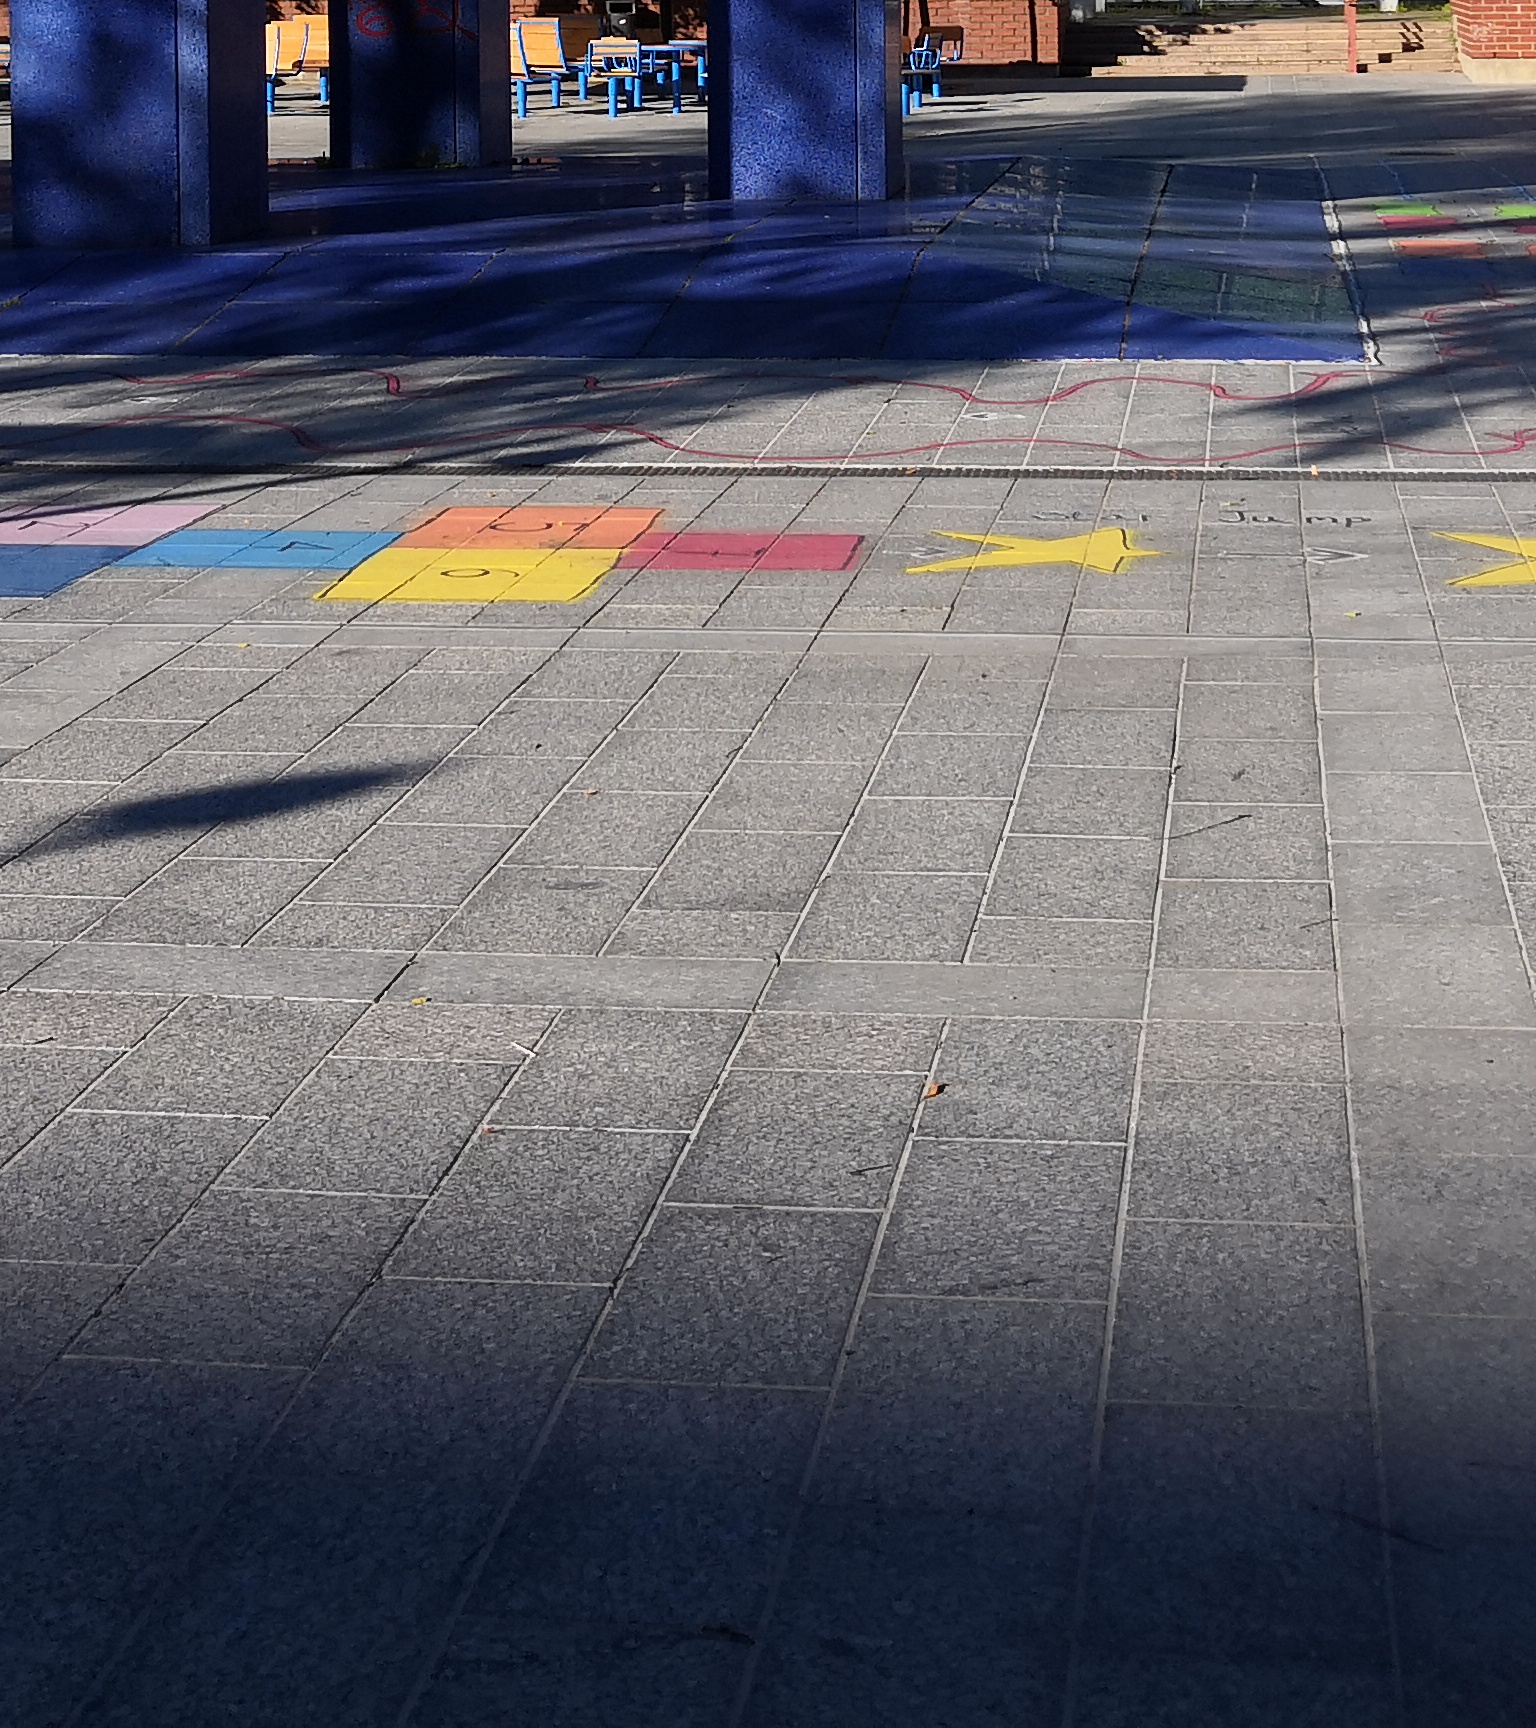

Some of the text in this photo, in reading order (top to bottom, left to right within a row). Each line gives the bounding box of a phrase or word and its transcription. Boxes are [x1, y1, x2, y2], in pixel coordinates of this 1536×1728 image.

[1217, 510, 1373, 528] Jump
[489, 520, 590, 533] 5
[440, 567, 520, 578] 6
